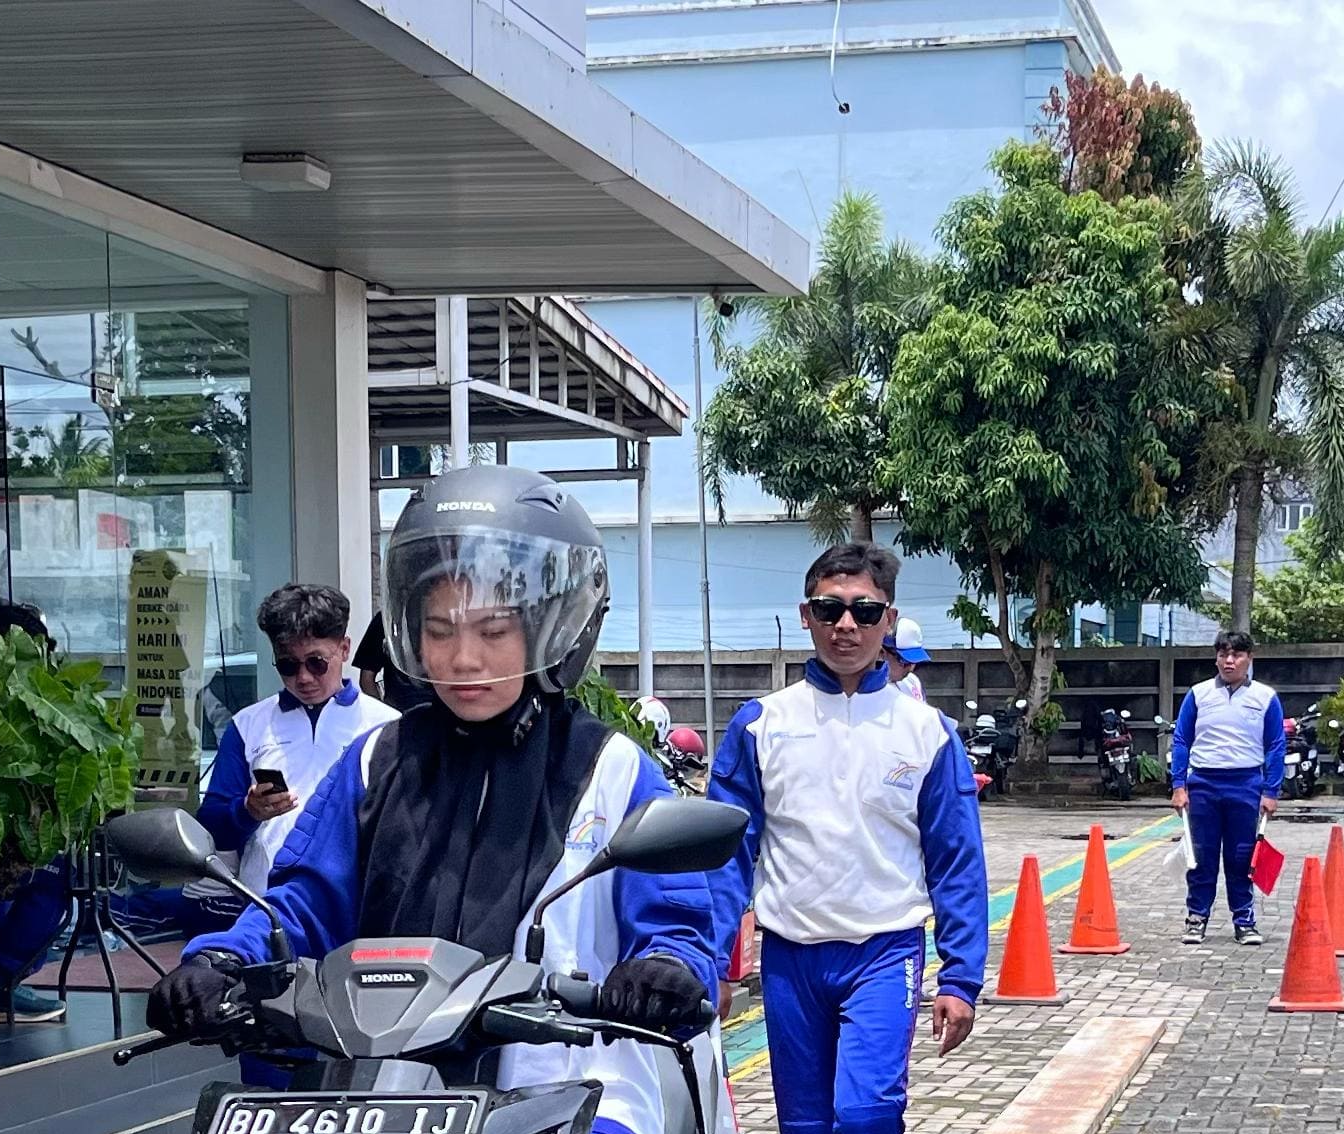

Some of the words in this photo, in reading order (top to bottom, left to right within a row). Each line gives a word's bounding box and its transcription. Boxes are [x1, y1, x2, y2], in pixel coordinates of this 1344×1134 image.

[436, 502, 496, 512] HONDA
[137, 586, 169, 599] AMAN
[136, 603, 191, 613] BERKEDARA
[137, 633, 167, 647] HARI
[136, 653, 164, 662] UNTUK
[136, 668, 166, 680] MASA
[361, 973, 416, 983] HONDA
